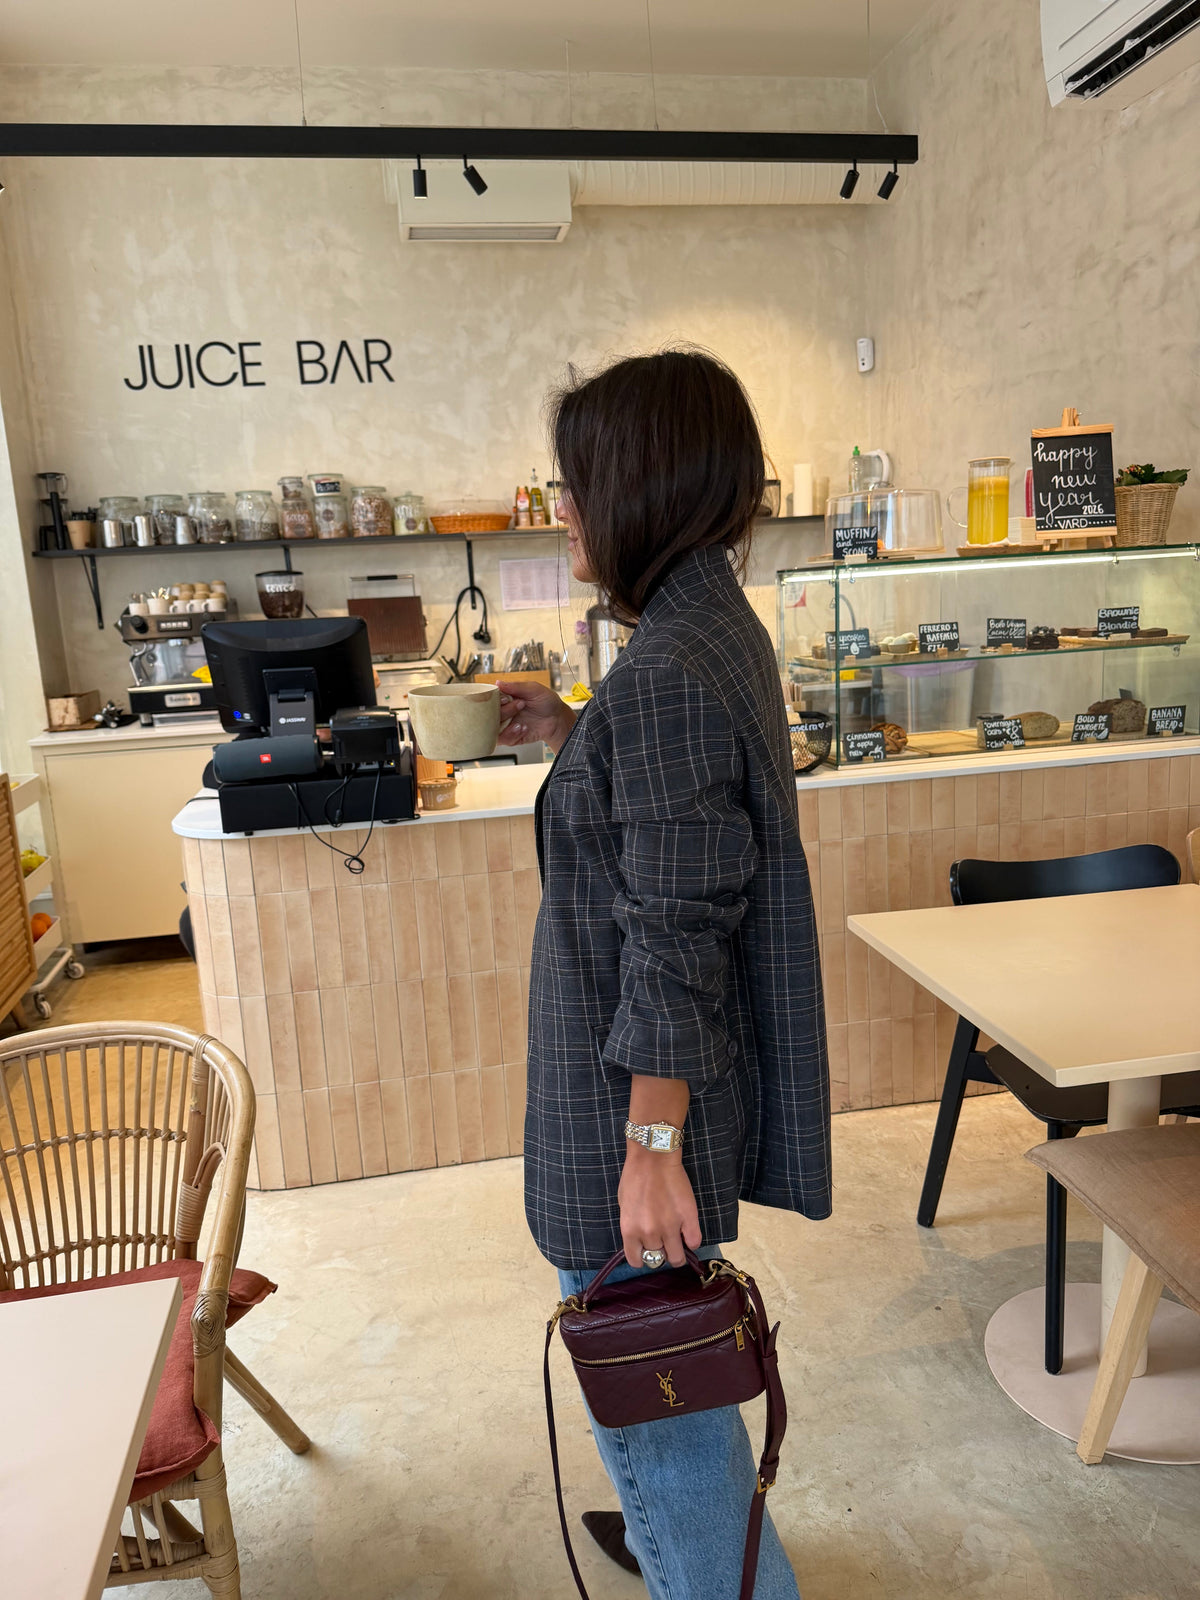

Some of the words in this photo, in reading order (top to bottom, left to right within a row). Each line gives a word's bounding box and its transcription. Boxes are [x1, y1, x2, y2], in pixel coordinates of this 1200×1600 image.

[124, 341, 266, 391] JUICE
[296, 339, 395, 385] BAR
[1034, 442, 1097, 472] happy
[1051, 474, 1097, 489] new
[1082, 503, 1104, 515] 2026
[836, 539, 853, 548] and
[920, 623, 951, 634] FERRERO
[1098, 621, 1138, 631] Blondie
[1151, 707, 1183, 719] BANANA
[1077, 715, 1096, 723] BOLO
[1155, 720, 1178, 733] BREAD
[1072, 732, 1080, 741] E
[849, 741, 855, 749] &
